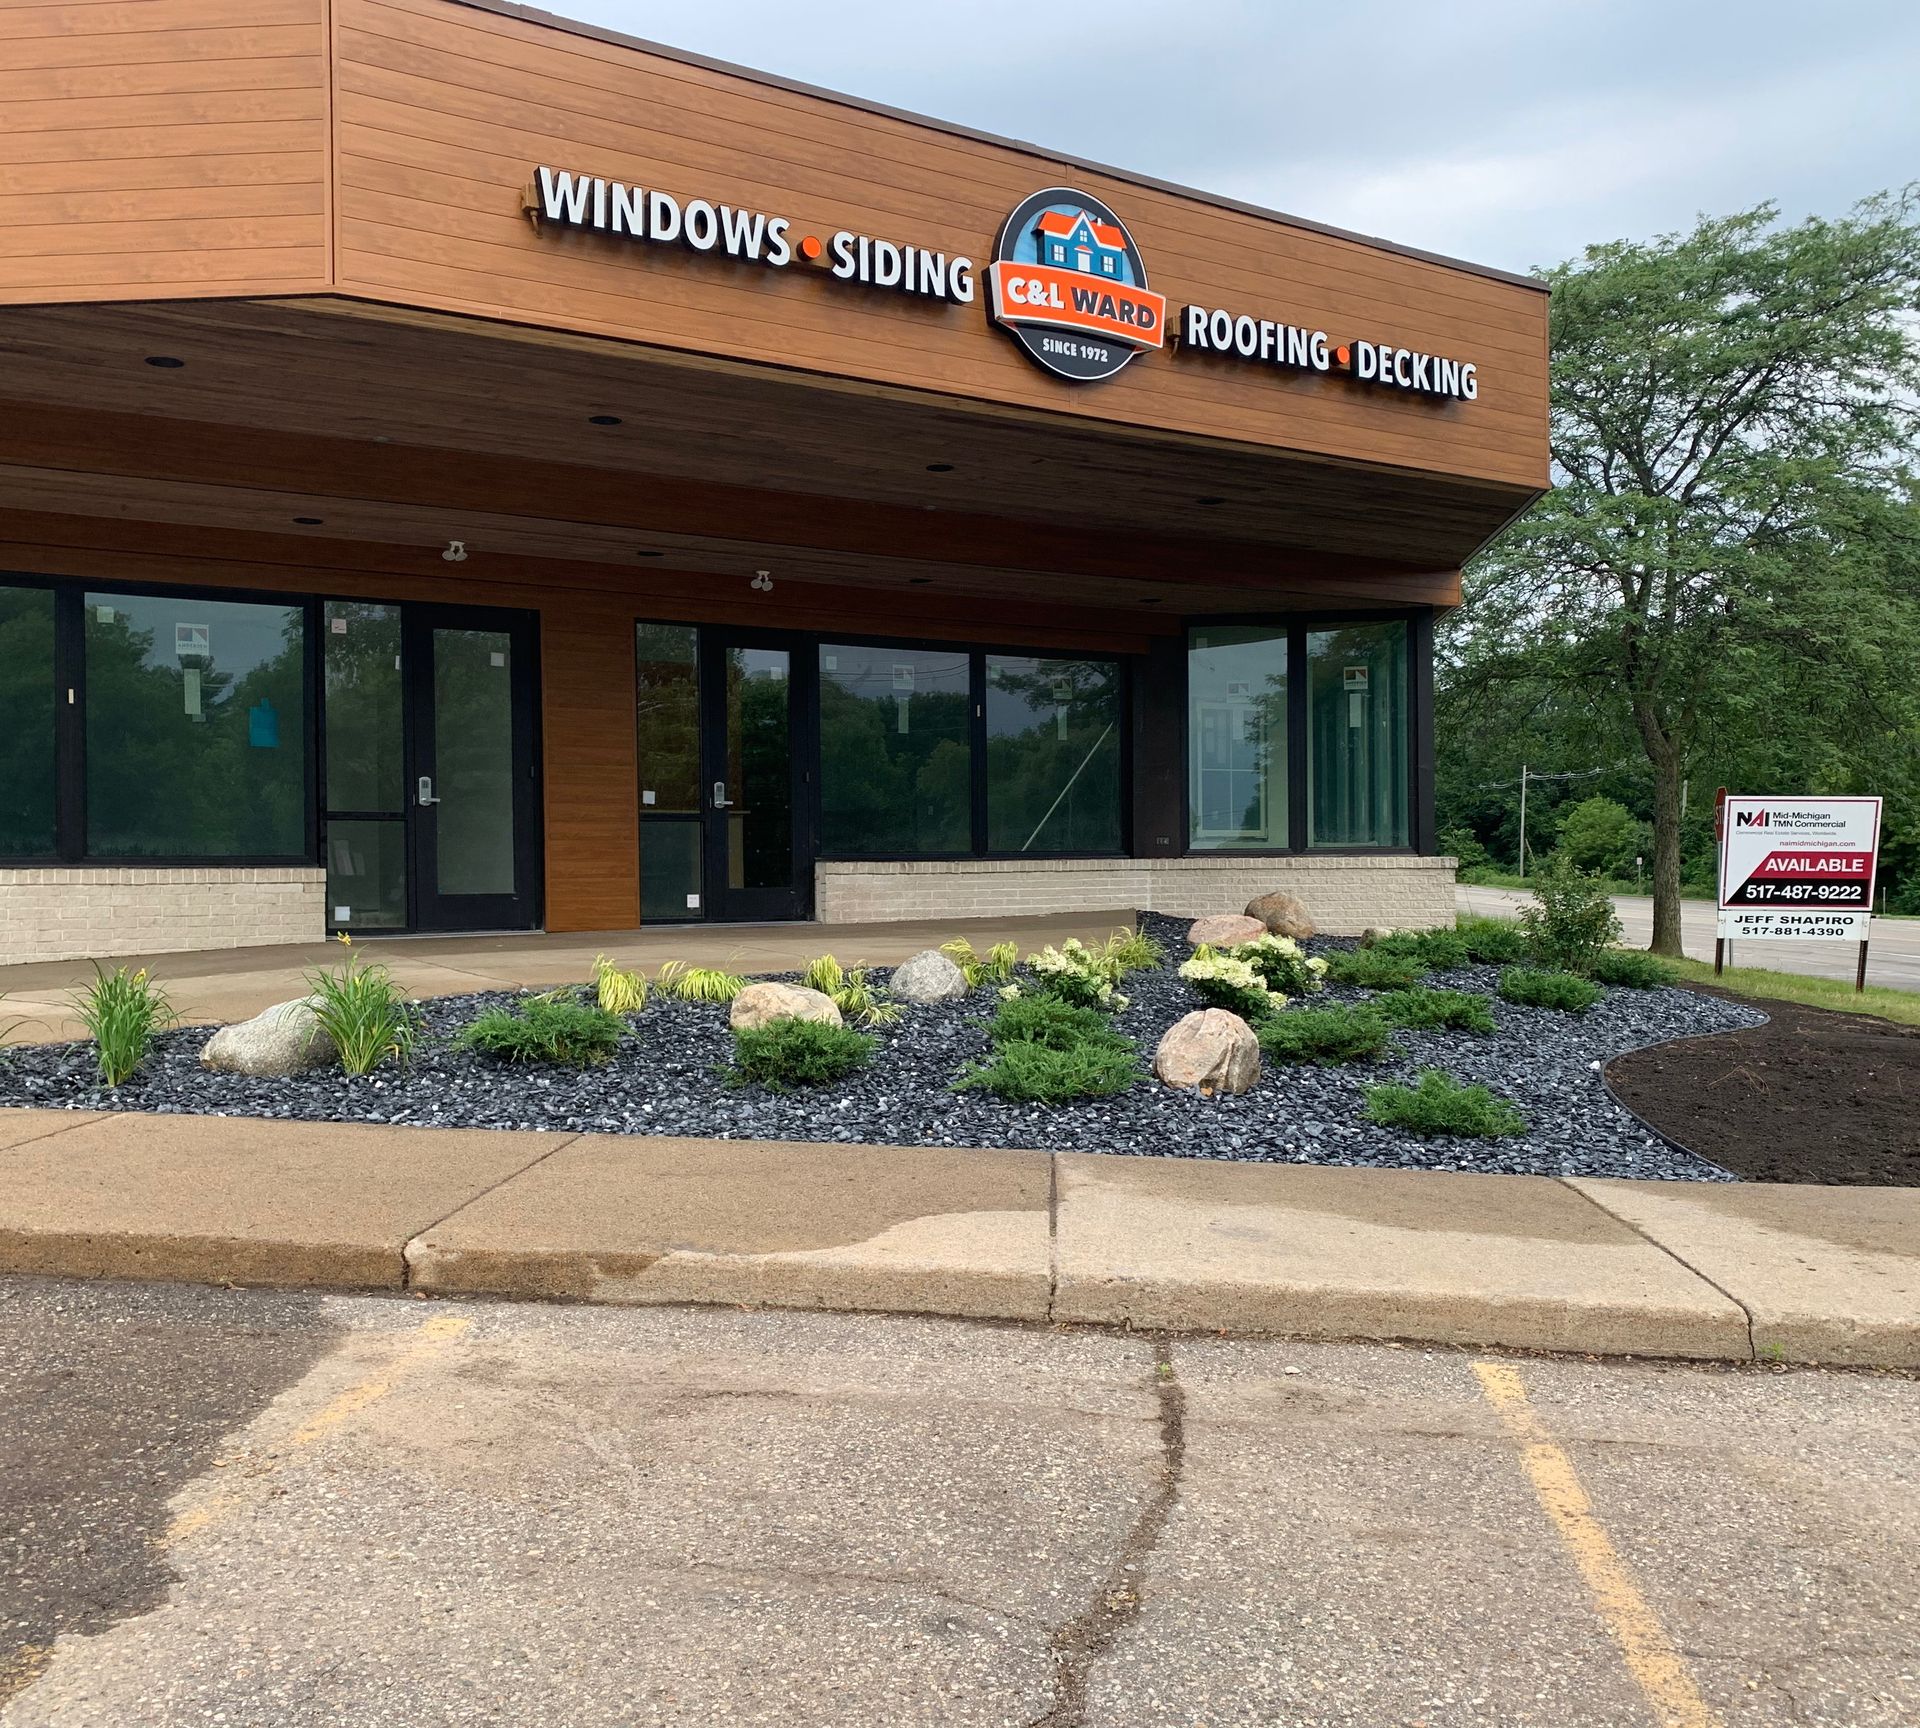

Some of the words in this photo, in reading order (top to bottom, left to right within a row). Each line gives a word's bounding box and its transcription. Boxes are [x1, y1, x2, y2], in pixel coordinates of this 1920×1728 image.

[537, 166, 791, 266] WINDOWS
[831, 231, 974, 302] SIDING
[1007, 277, 1065, 310] C&L
[1071, 286, 1157, 330] WARD
[1042, 338, 1077, 357] SINCE
[1079, 345, 1108, 363] 1972
[1187, 304, 1330, 371] ROOFING
[1357, 340, 1478, 400] DECKING
[1736, 808, 1770, 827] NAI
[1772, 811, 1831, 821] Mid-Michigan
[1773, 820, 1793, 828] TMN
[1794, 820, 1847, 828] Commercial
[1779, 840, 1856, 848] naimidmichigan.com
[1764, 858, 1864, 872] AVAILABLE
[1745, 885, 1861, 900] 517-487-9222
[1734, 915, 1775, 924] JEFF
[1780, 916, 1854, 925] SHAPIRO
[1742, 927, 1844, 936] 517-881-4390
